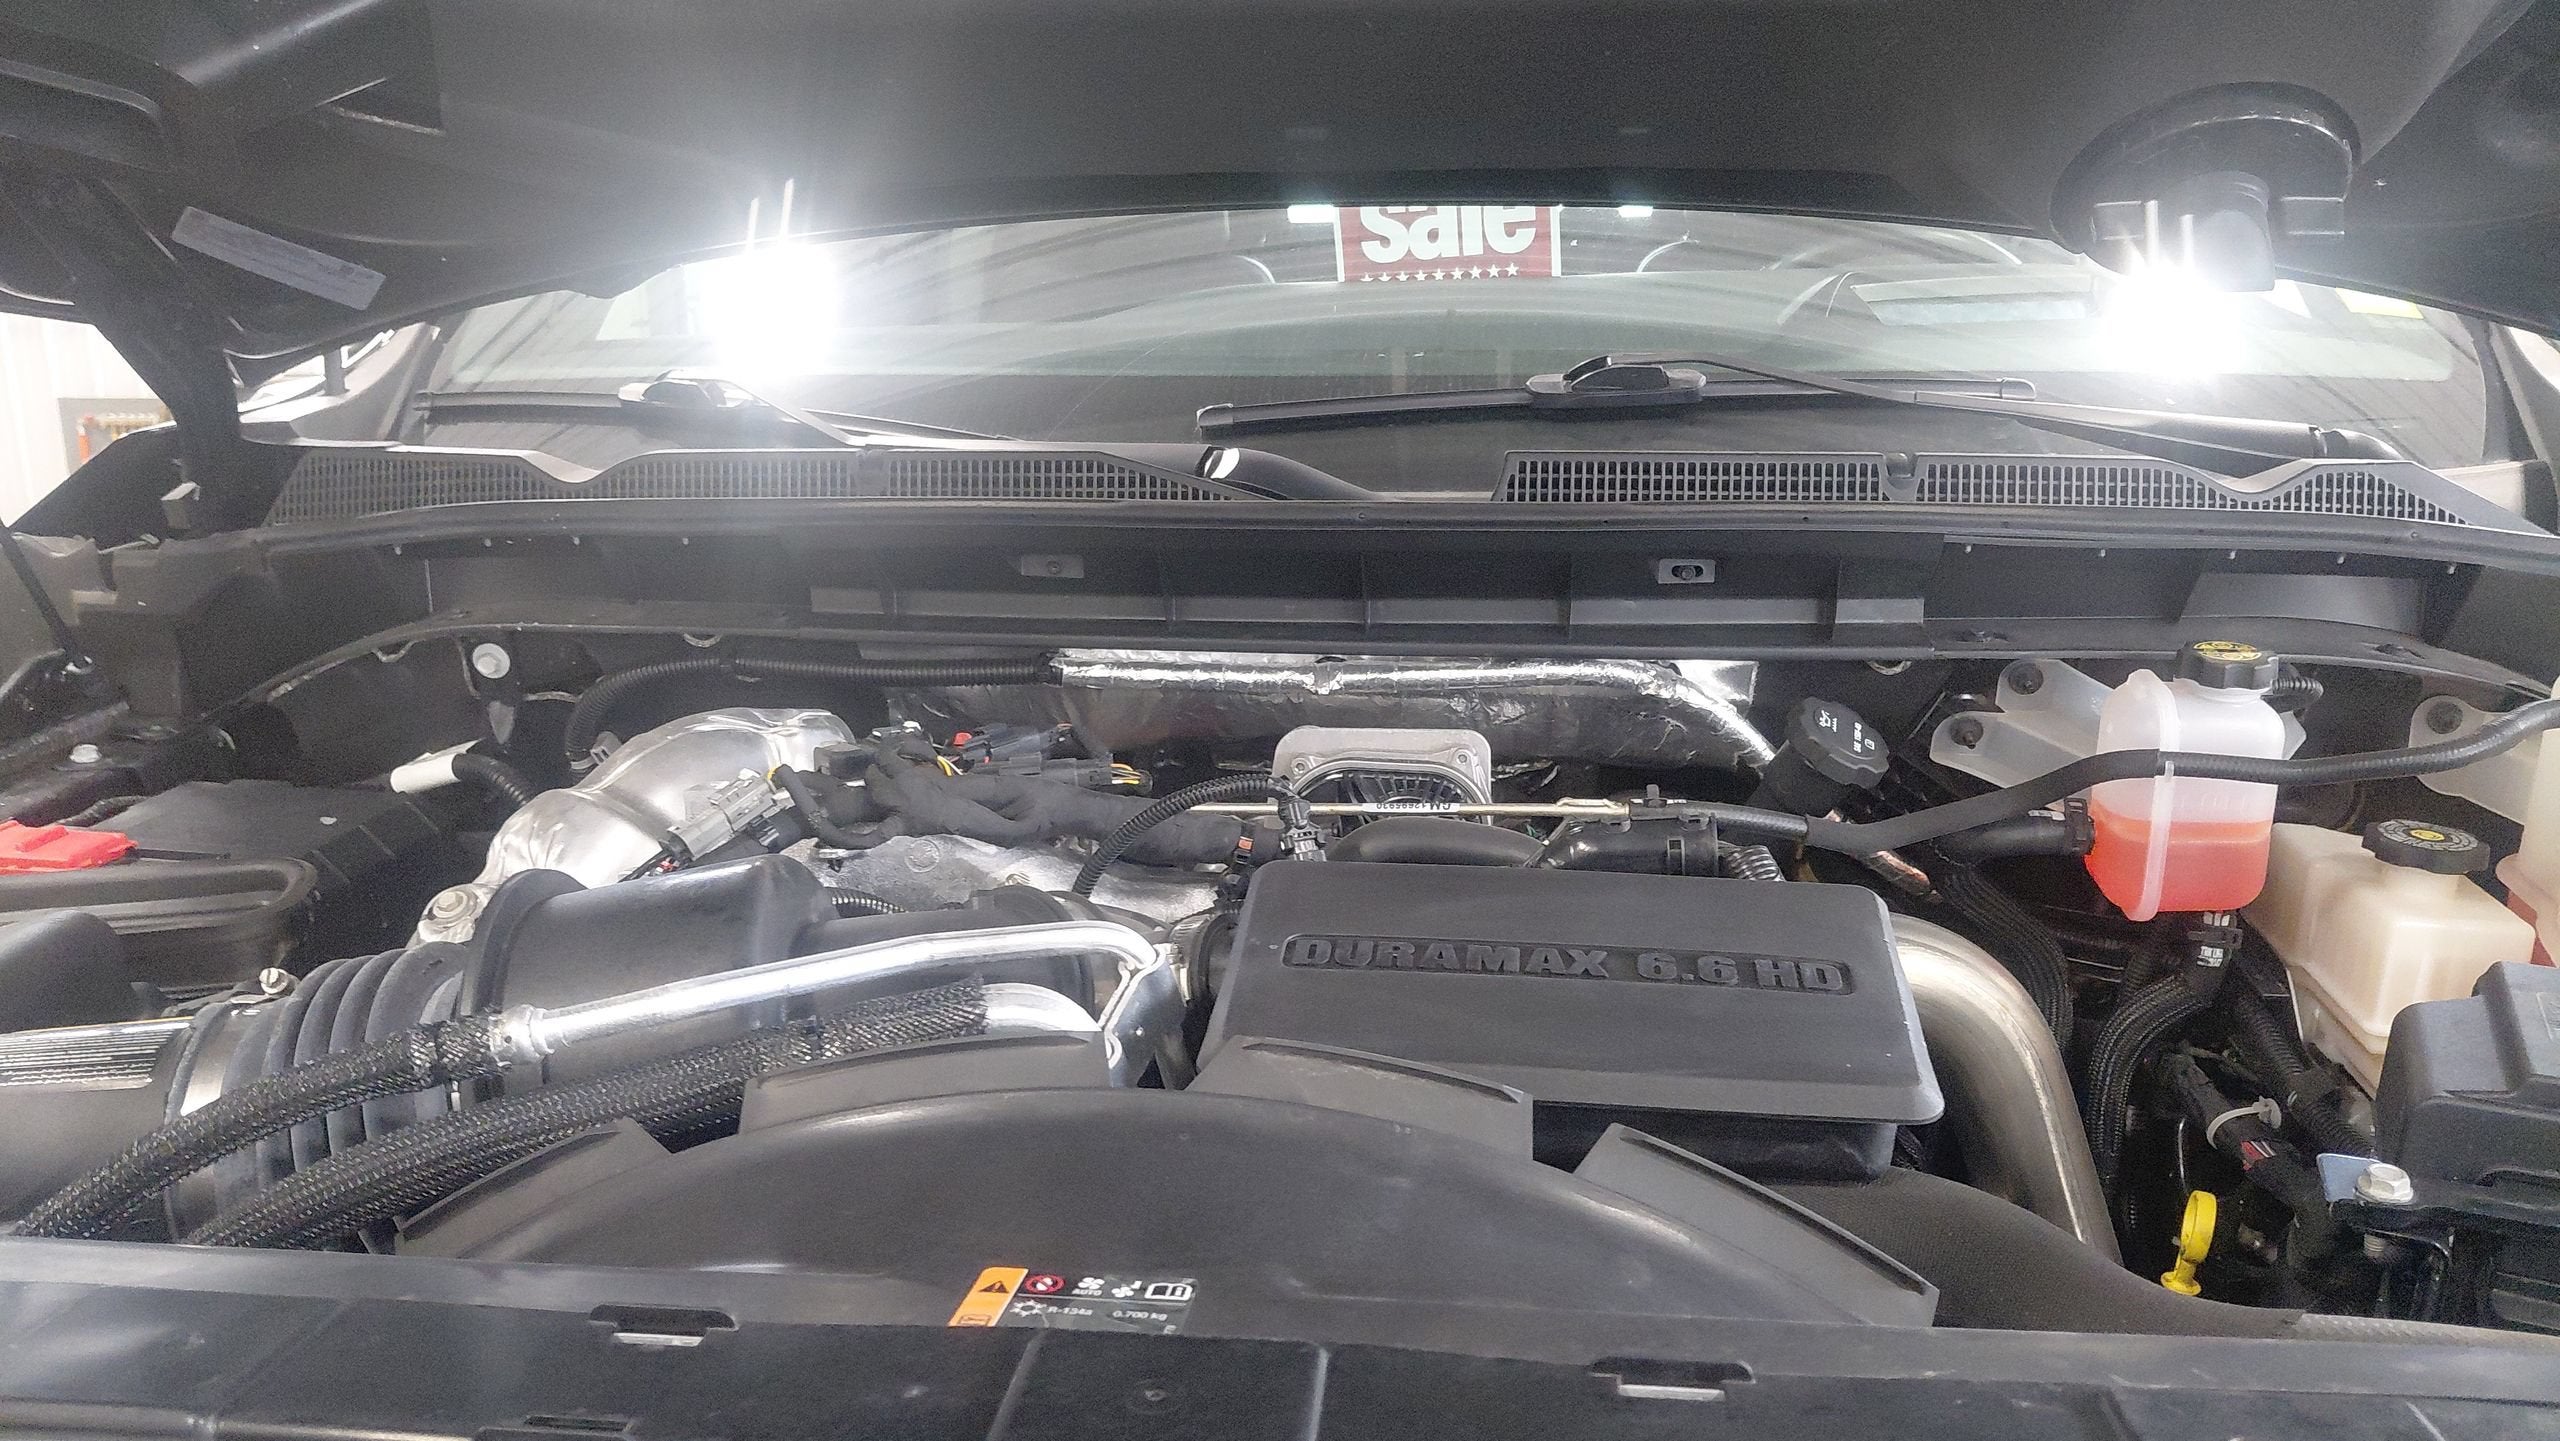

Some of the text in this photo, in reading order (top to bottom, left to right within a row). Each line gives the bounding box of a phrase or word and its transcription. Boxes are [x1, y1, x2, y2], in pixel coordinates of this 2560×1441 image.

[1294, 938, 1844, 991] DURAMAX 6.6 HD
[1112, 1310, 1149, 1318] 0.700
[1150, 1312, 1168, 1321] kg
